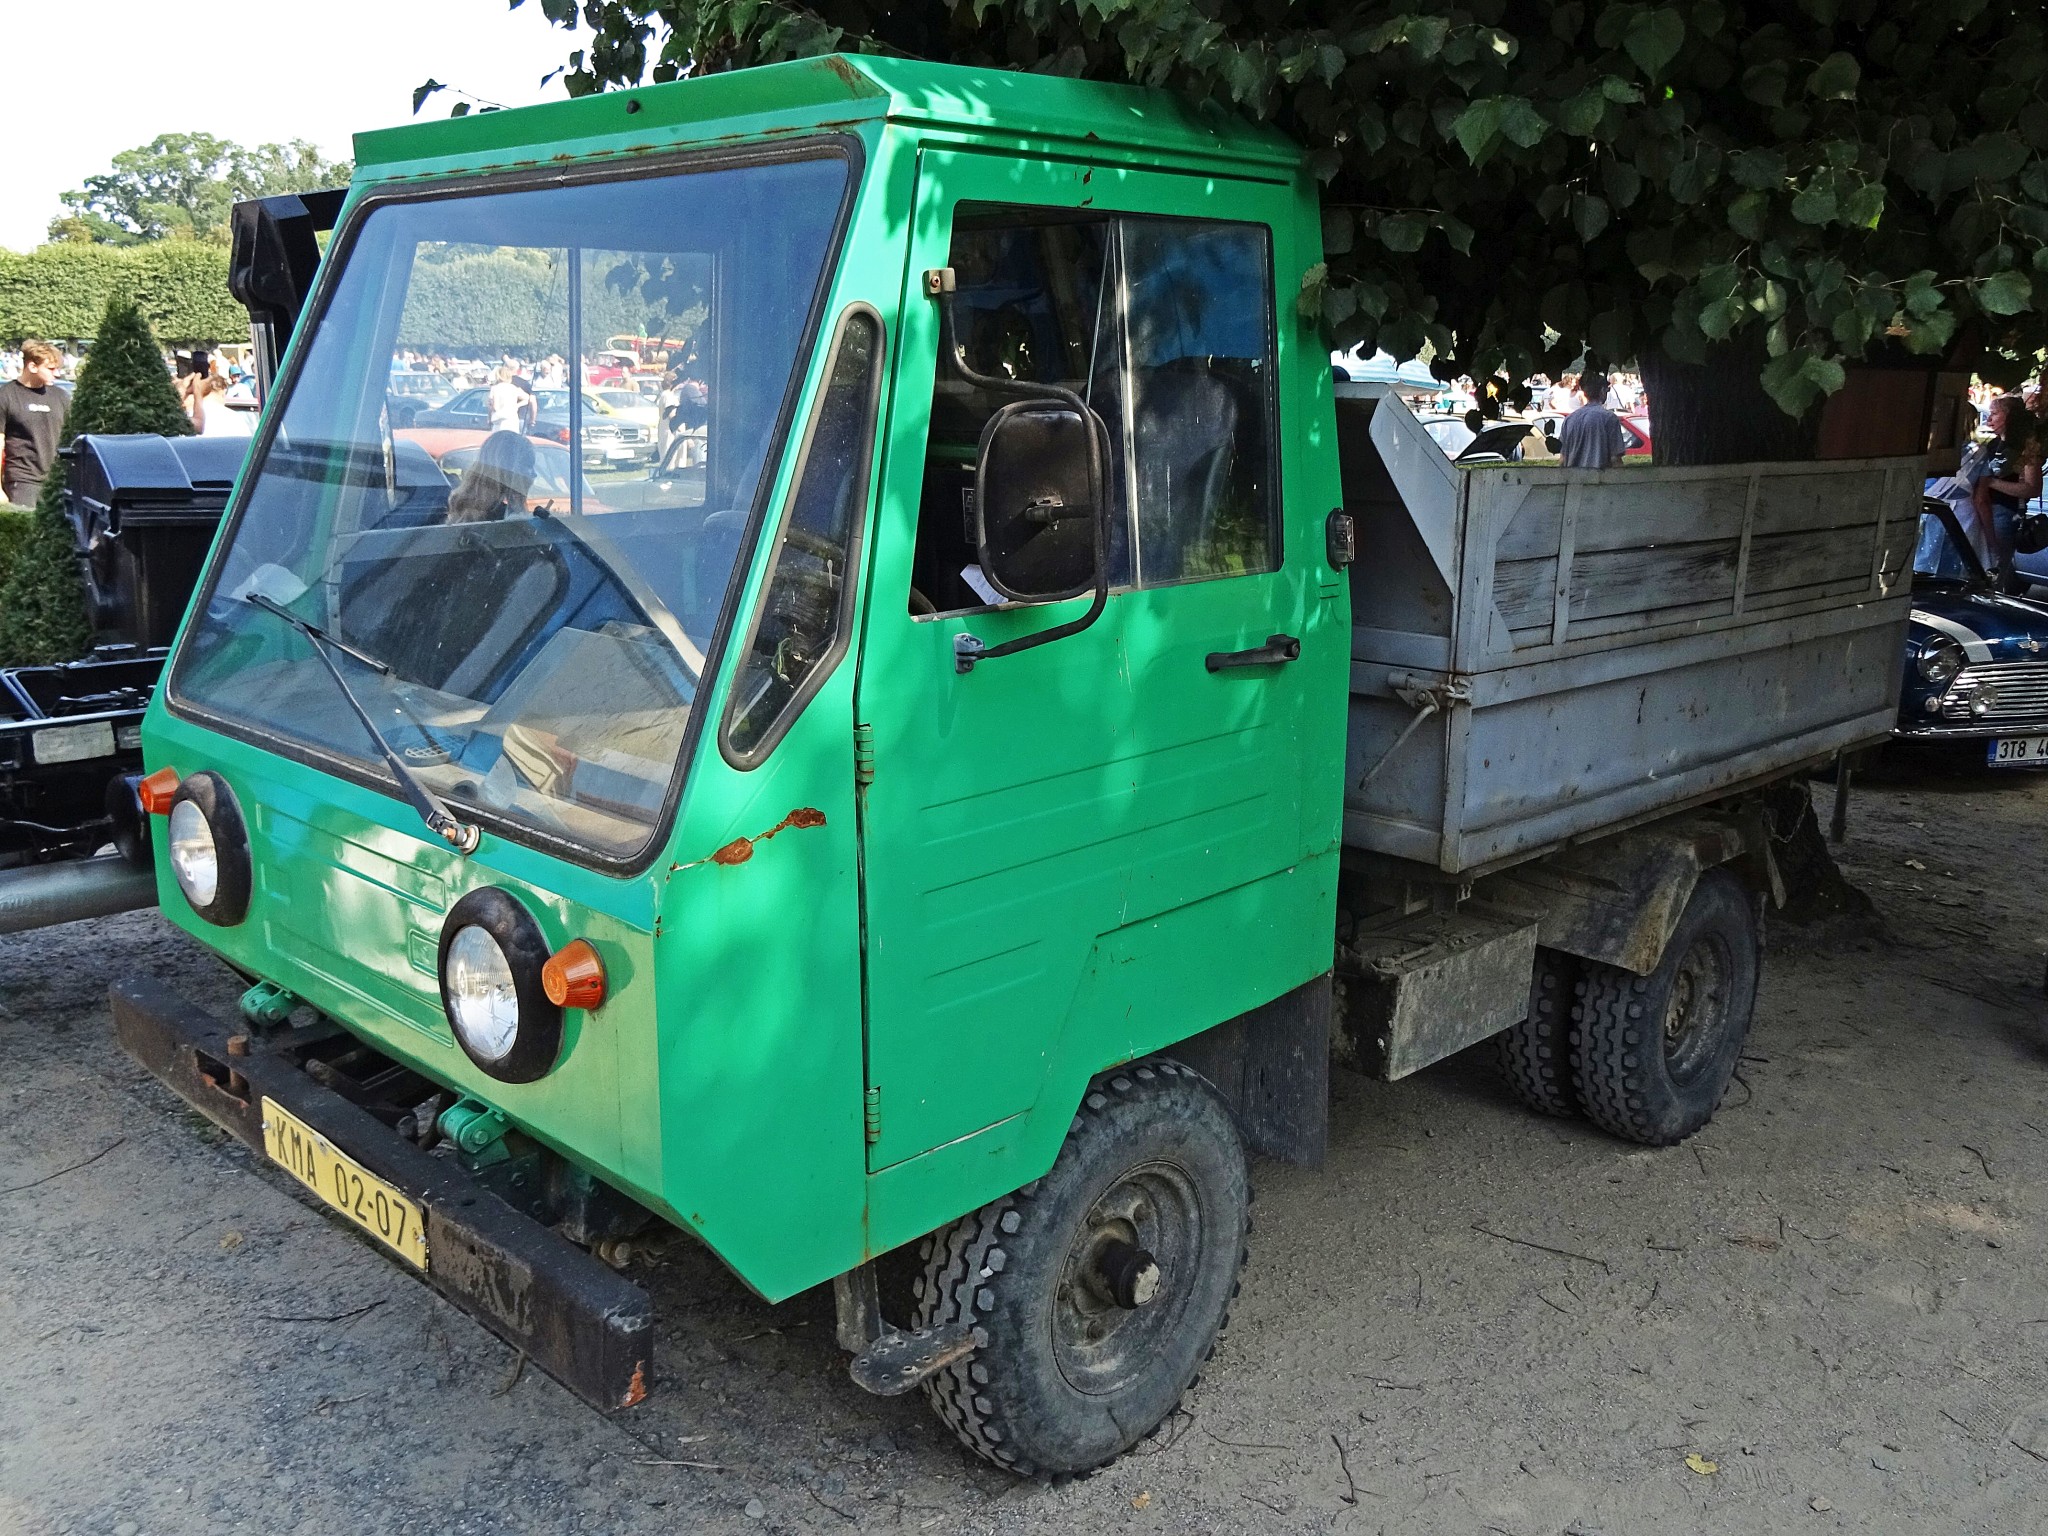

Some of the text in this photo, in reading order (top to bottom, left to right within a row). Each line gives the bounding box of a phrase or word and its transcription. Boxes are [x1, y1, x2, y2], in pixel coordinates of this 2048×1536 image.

[1999, 739, 2048, 759] 3T8 4
[276, 1116, 407, 1246] KMA 02-07
